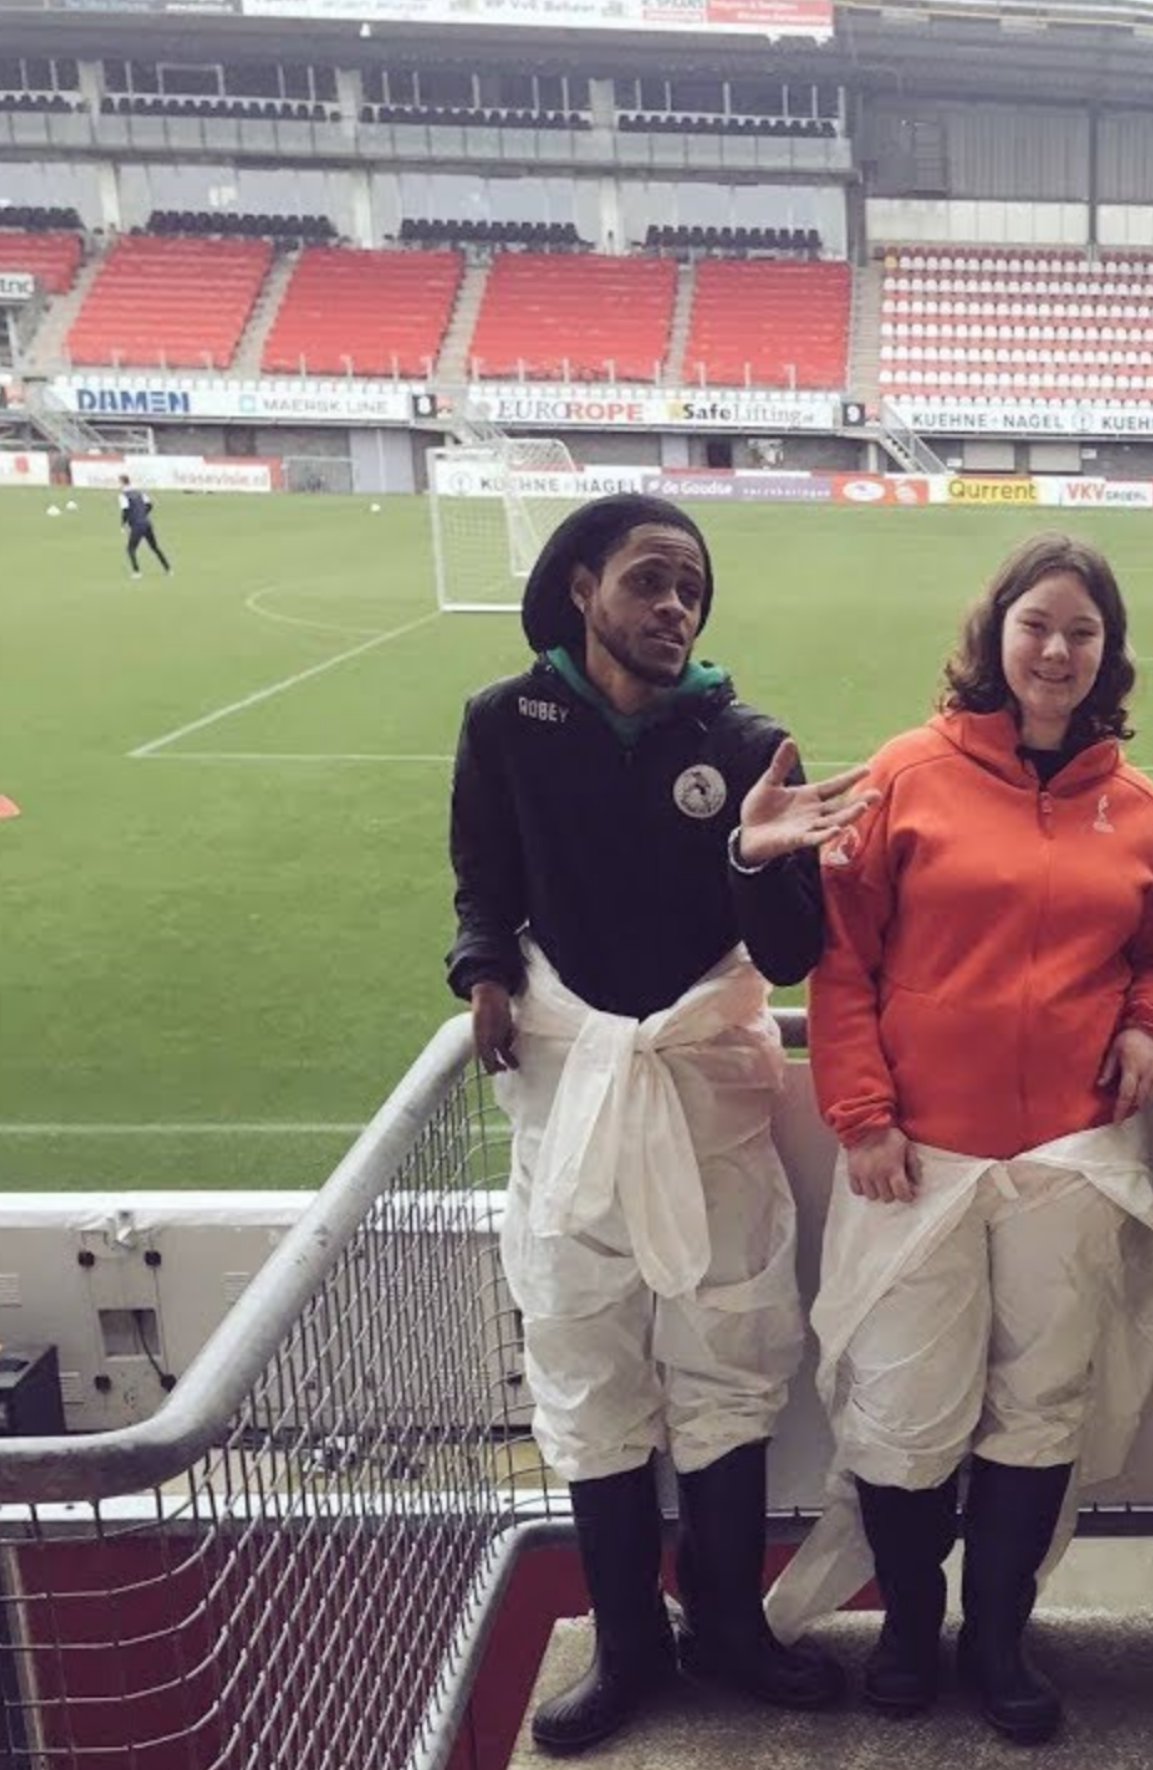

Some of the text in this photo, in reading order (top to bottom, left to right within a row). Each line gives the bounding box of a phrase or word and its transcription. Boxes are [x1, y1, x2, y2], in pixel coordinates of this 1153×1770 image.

[77, 389, 190, 413] DAMEN
[262, 399, 389, 414] MAERSK LINE
[497, 400, 644, 422] EUROROPE
[846, 397, 860, 422] 9
[912, 413, 987, 427] KUEHNE
[1003, 414, 1064, 428] NAGEL
[949, 479, 1037, 500] Qurrent
